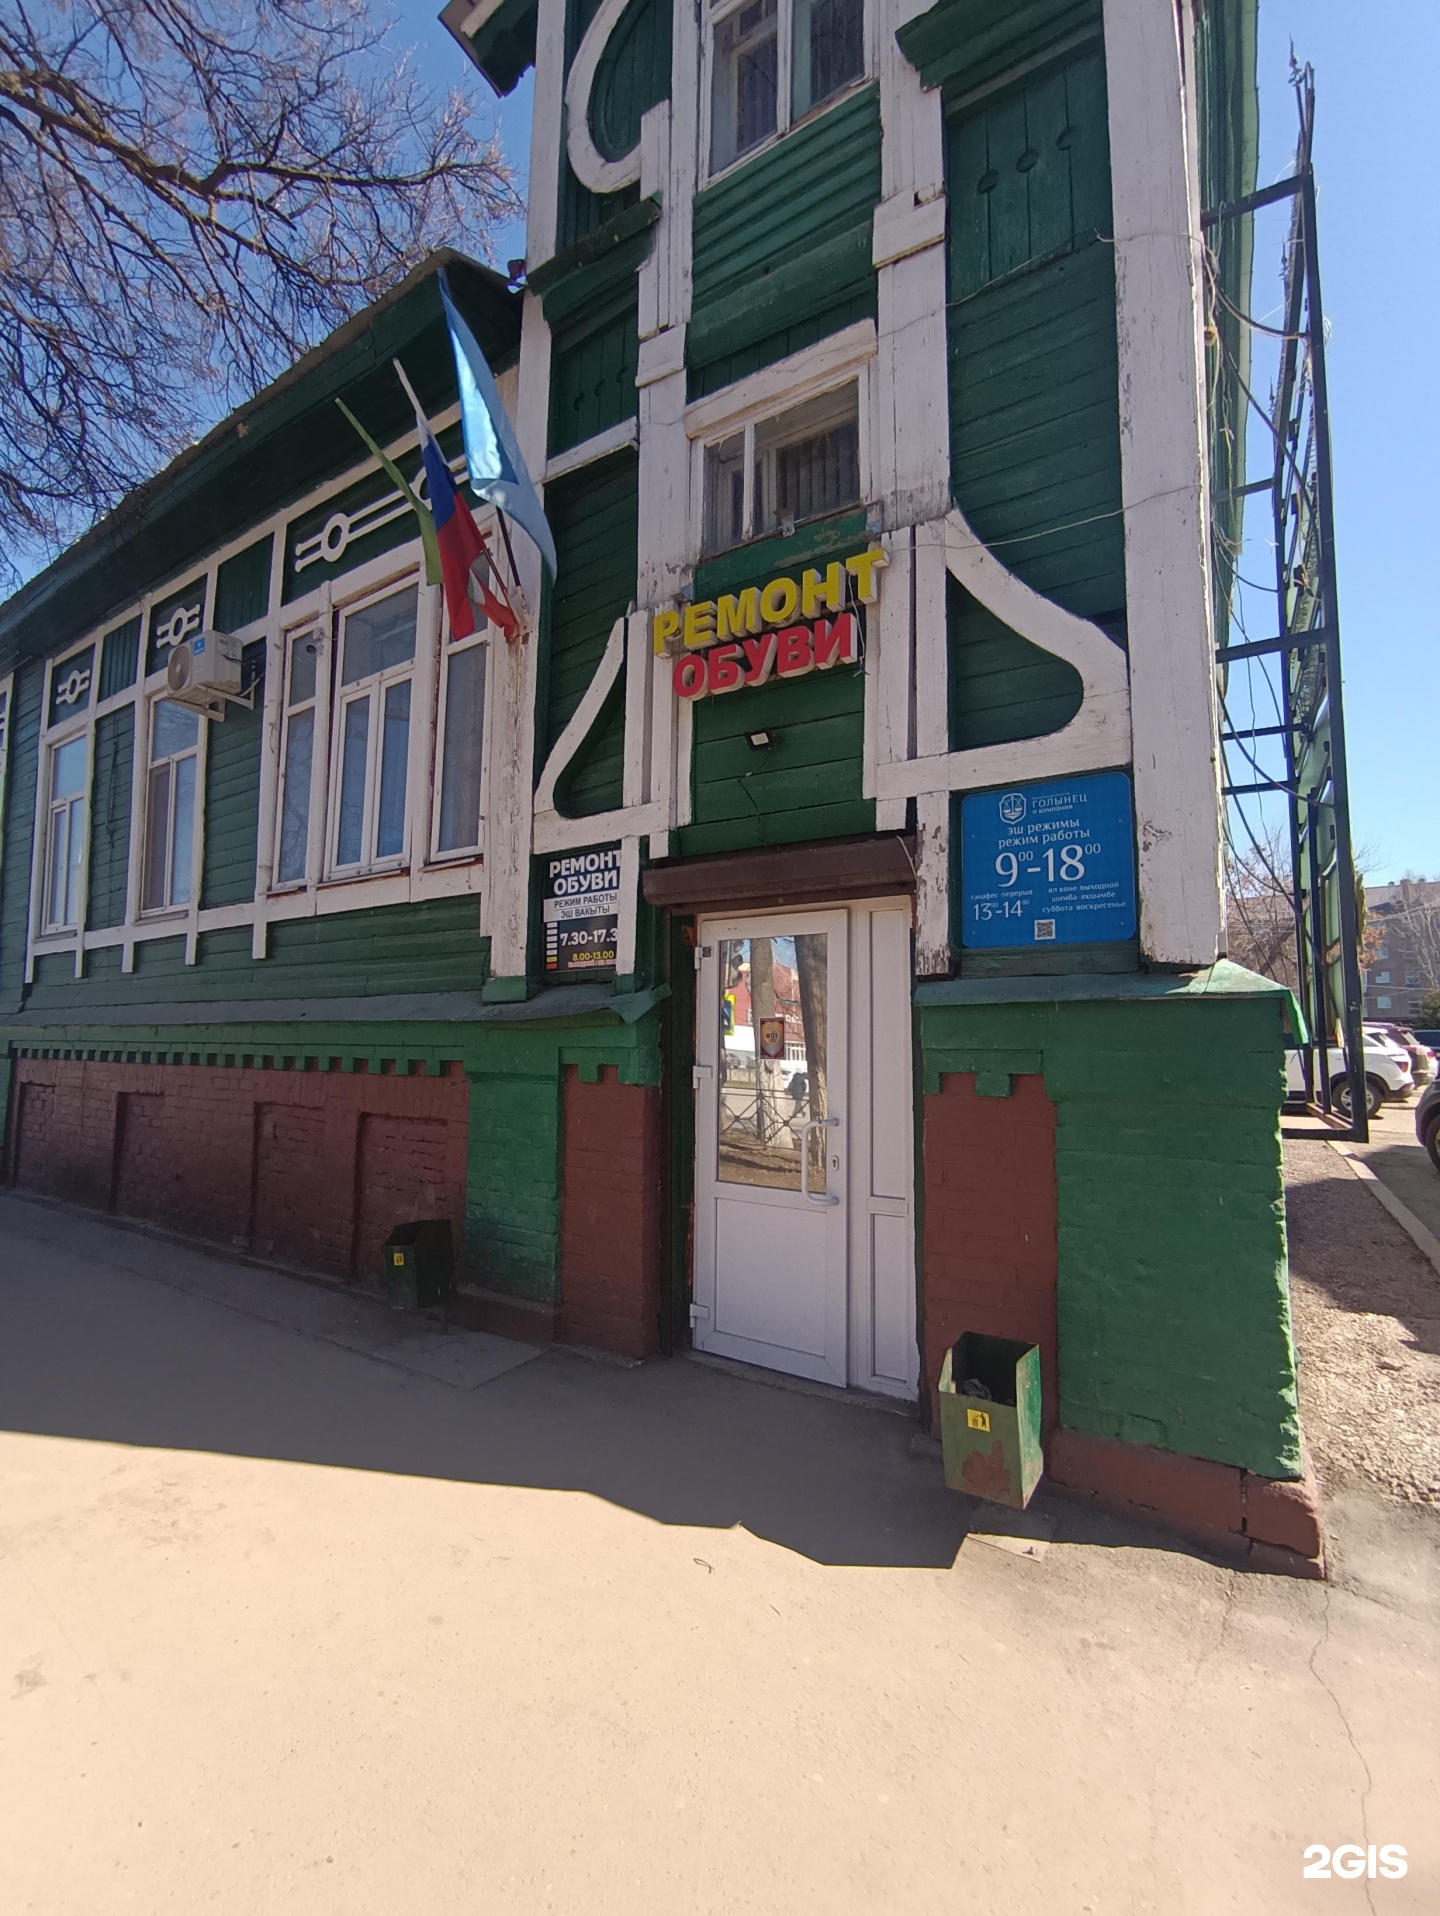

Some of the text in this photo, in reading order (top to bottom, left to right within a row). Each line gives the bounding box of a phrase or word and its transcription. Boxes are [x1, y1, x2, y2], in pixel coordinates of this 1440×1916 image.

[653, 548, 889, 659] РЕМОНТ
[672, 613, 858, 701] ОБУВИ
[1032, 794, 1088, 809] ГОЛЫНЕЦ
[1039, 804, 1072, 813] компания
[1007, 819, 1079, 836] эш режимы
[998, 829, 1090, 849] режим работы
[549, 849, 622, 878] РЕМОНТ
[553, 869, 618, 896] ОБУВИ
[554, 893, 617, 908] РЕЖИМ РАБОТЫ
[561, 905, 609, 918] ЭШ ВАКЫТЫ
[572, 951, 614, 961] 8.00-13.00
